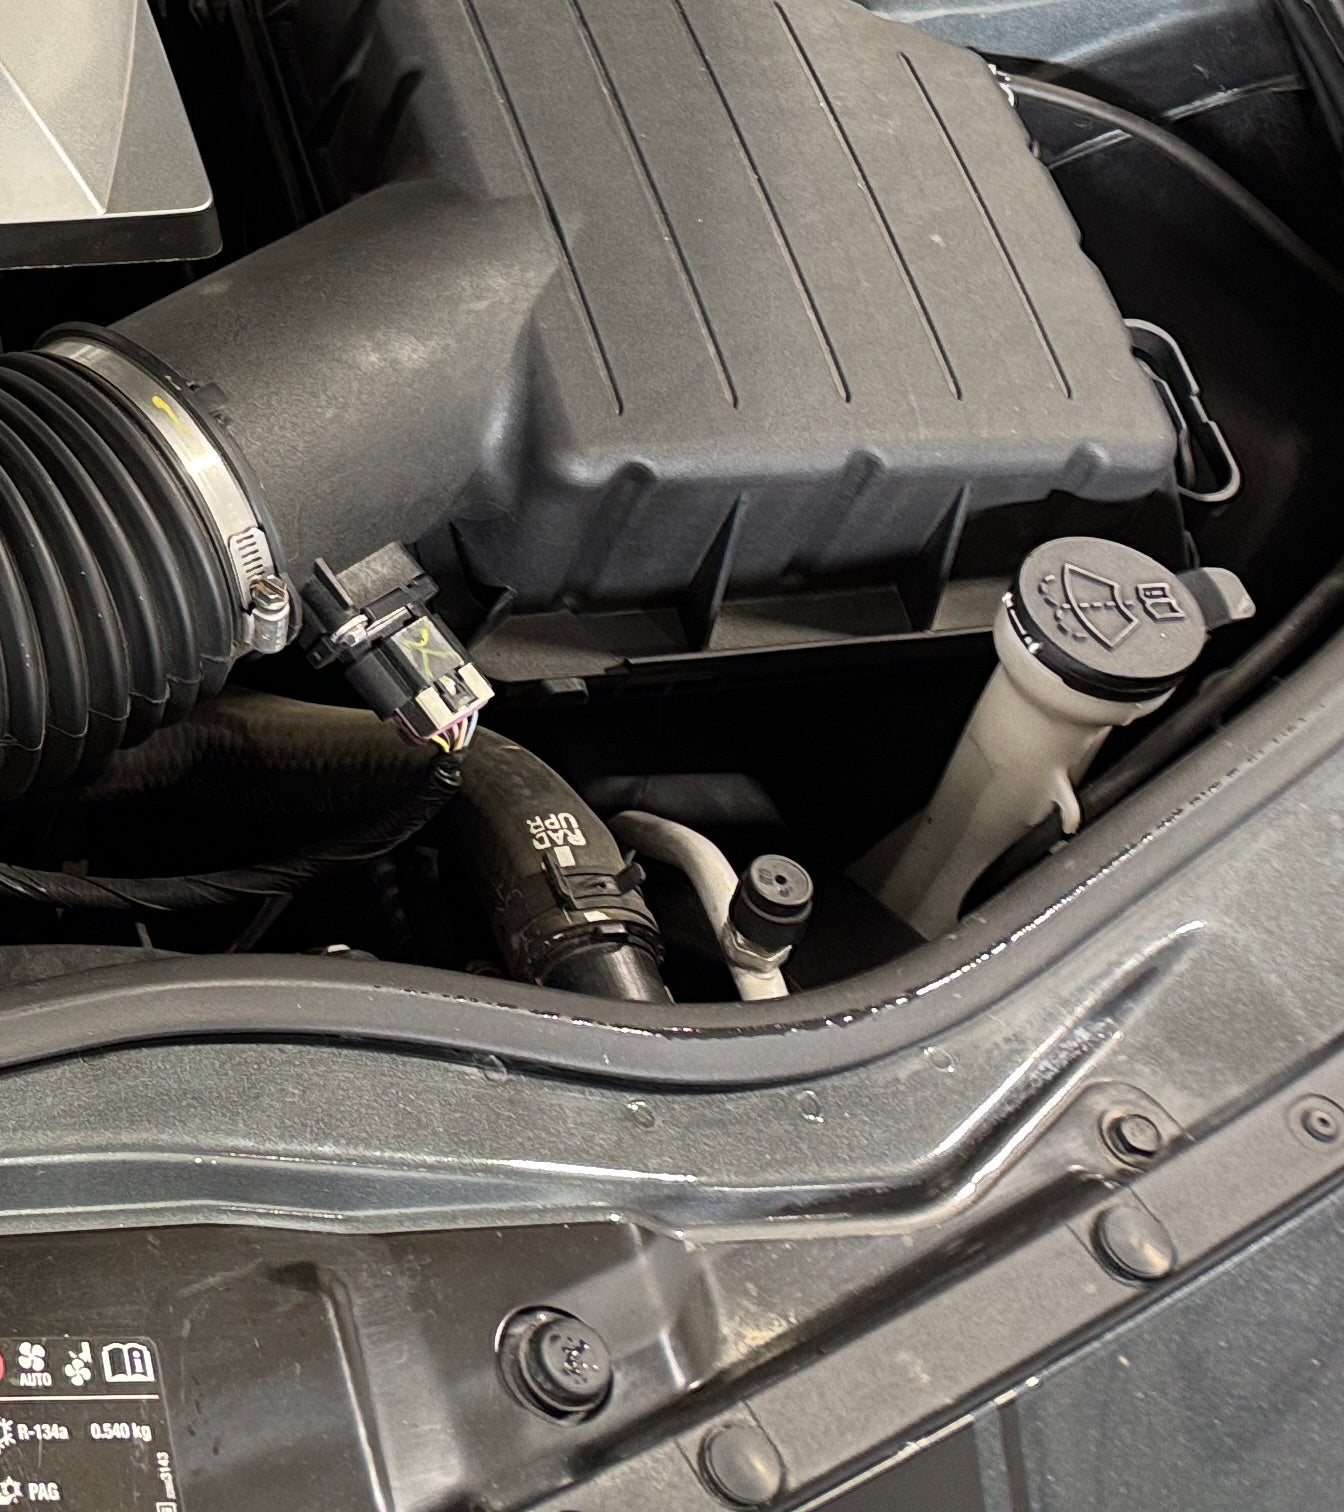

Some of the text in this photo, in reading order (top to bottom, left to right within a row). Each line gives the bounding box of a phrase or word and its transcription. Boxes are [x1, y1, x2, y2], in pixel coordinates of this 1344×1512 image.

[526, 812, 579, 834] UPR
[532, 828, 587, 850] RAD
[19, 1372, 53, 1387] AUTO
[17, 1421, 153, 1443] R-134a 0.540 kg
[28, 1482, 61, 1502] PAG
